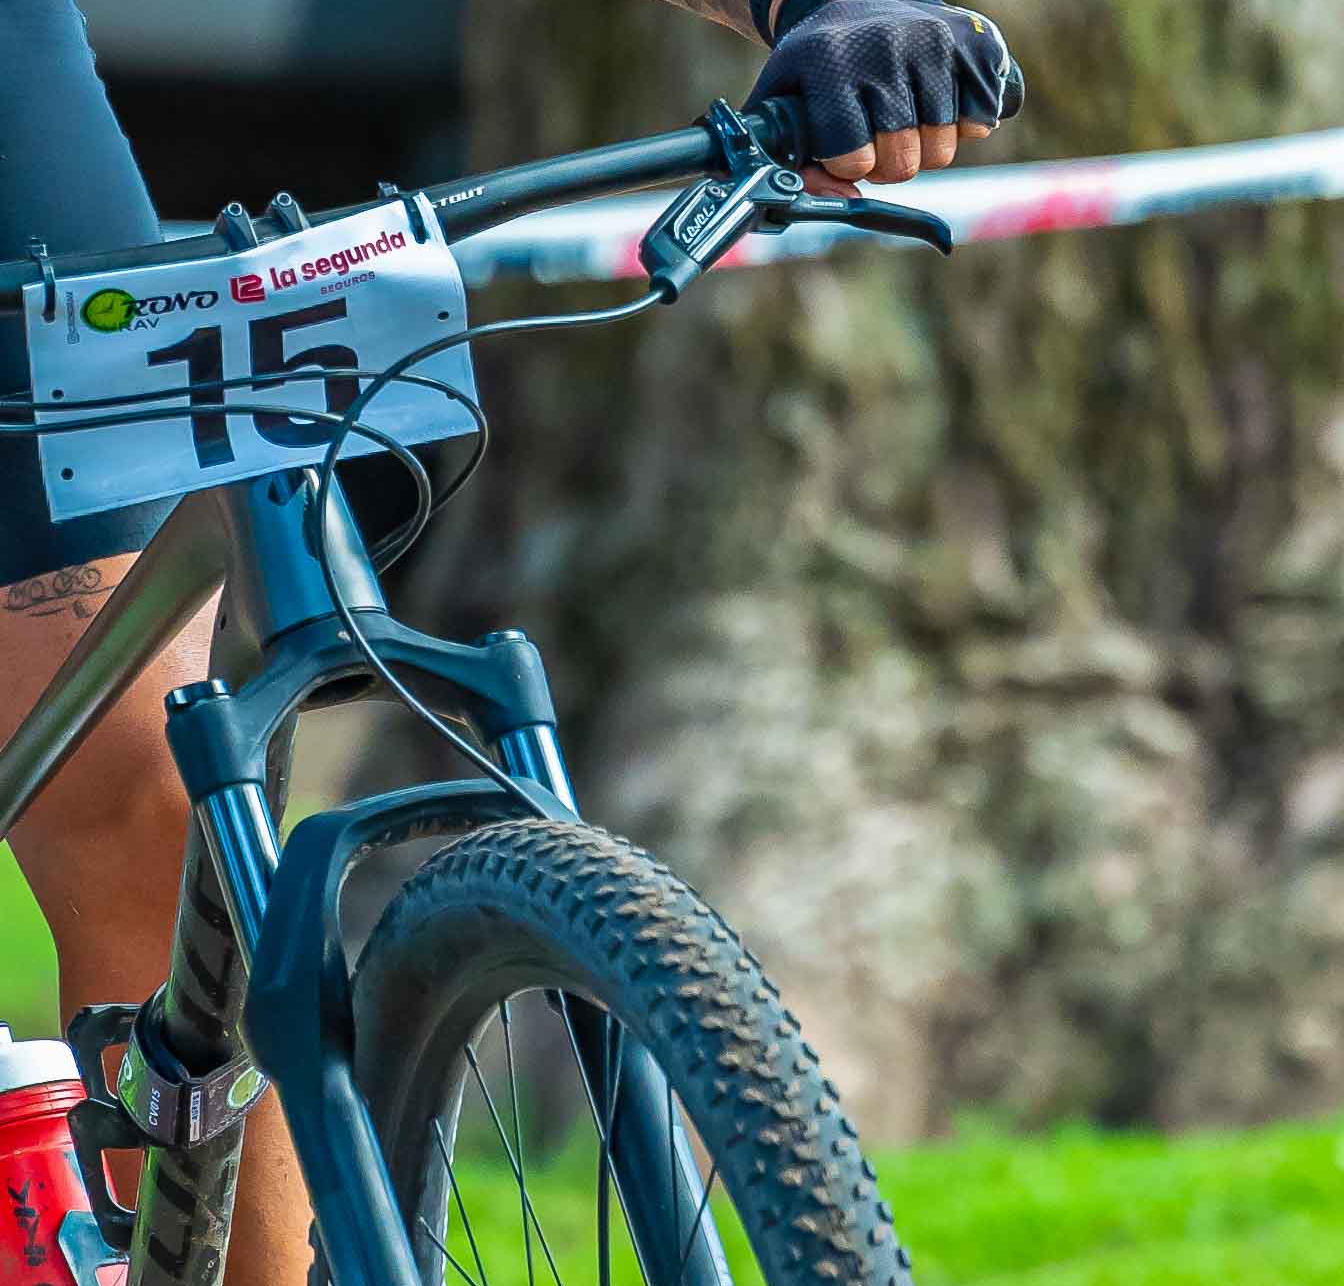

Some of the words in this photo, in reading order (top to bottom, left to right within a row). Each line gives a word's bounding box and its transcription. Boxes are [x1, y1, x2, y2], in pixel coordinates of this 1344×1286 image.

[269, 267, 298, 291] la
[301, 231, 407, 283] segunda
[320, 271, 376, 295] SEGUROS
[146, 297, 360, 469] 15
[149, 1087, 161, 1126] CV015
